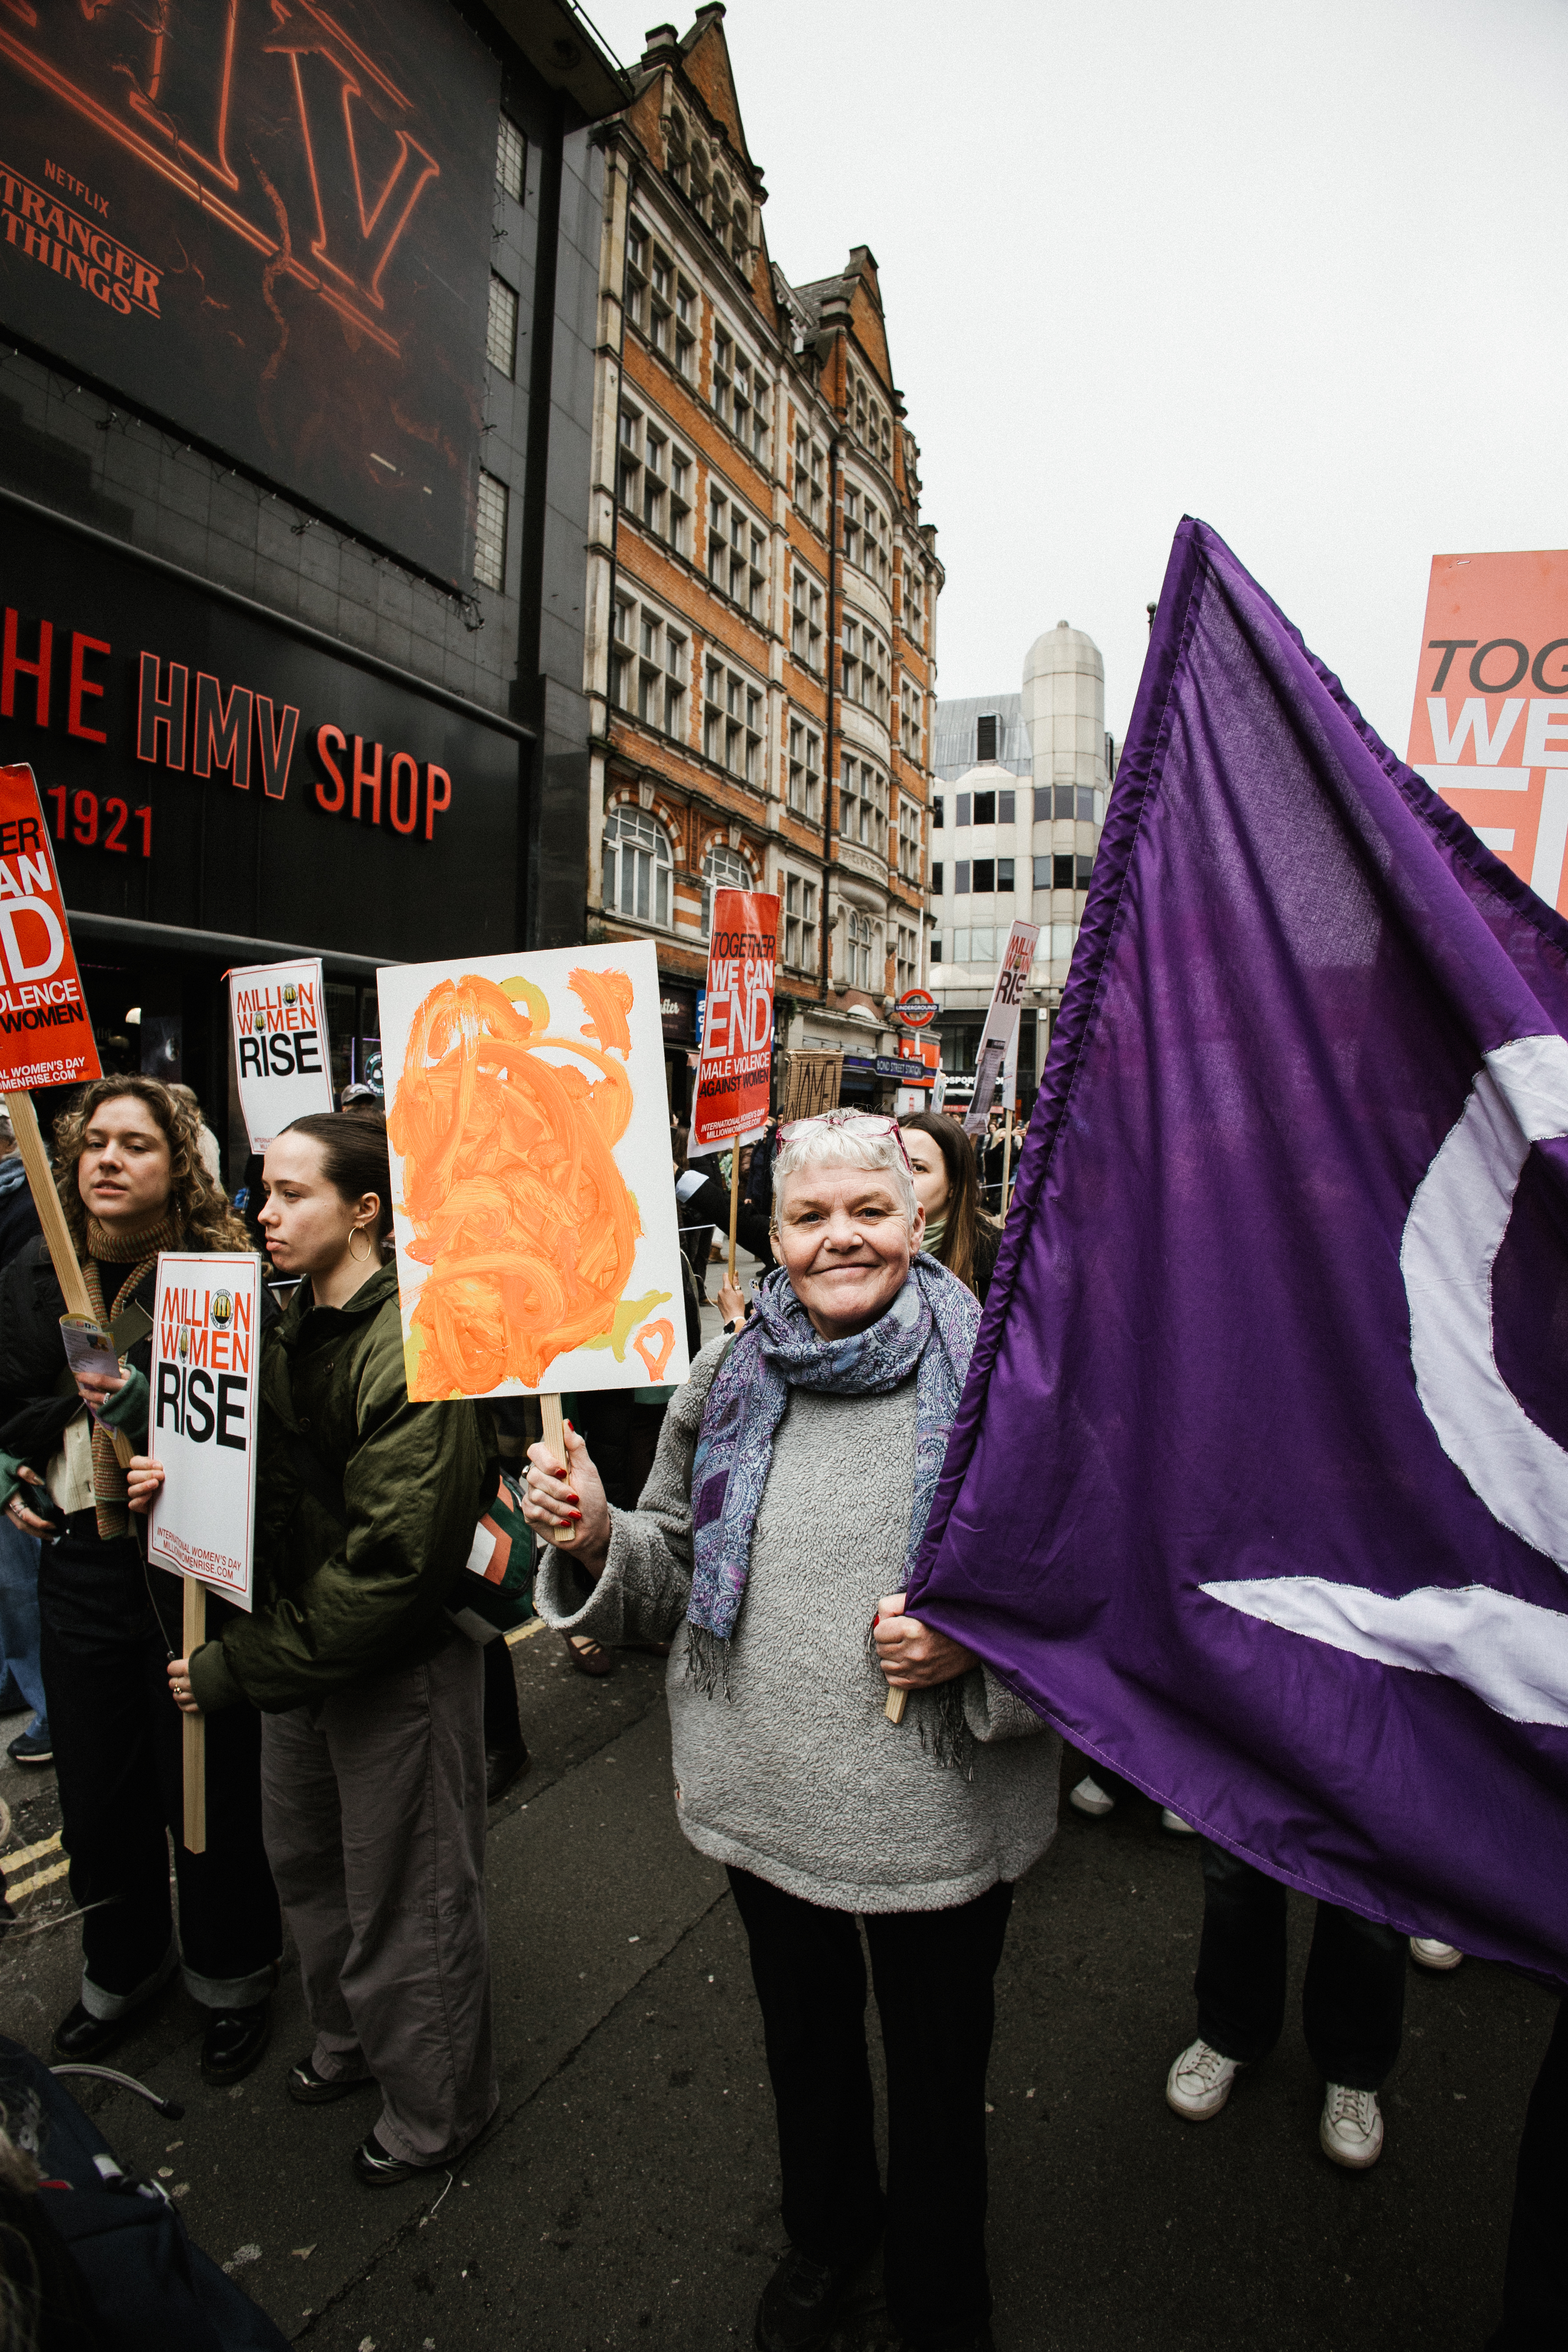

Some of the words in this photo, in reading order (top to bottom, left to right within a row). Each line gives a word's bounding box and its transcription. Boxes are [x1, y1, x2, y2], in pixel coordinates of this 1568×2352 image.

[44, 158, 109, 218] NETFLIX
[1, 208, 132, 315] THINGS
[2, 607, 111, 744] HE
[137, 651, 300, 800] HMV
[315, 724, 452, 840] SHOP
[1426, 697, 1568, 768] WE
[47, 784, 152, 857] 1921
[713, 932, 776, 958] TOGETHER
[712, 960, 740, 992] WE
[744, 959, 773, 990] CAN
[702, 988, 772, 1060] END
[11, 1060, 64, 1078] WOMEN'S
[65, 1056, 85, 1069] DAY
[239, 1030, 323, 1078] RISE
[701, 1060, 732, 1081] MALE
[733, 1052, 770, 1075] VIOLENCE
[876, 1060, 890, 1071] BOND
[891, 1062, 905, 1073] STREET
[905, 1064, 921, 1076] STATION
[699, 1075, 742, 1099] AGAINST
[743, 1068, 769, 1088] WOMEN
[701, 1116, 740, 1132] INTERNATIONAL
[757, 1107, 765, 1116] DAY
[156, 1361, 248, 1452] RISE
[192, 1546, 226, 1566] WOMEN'S
[228, 1558, 241, 1571] DAY
